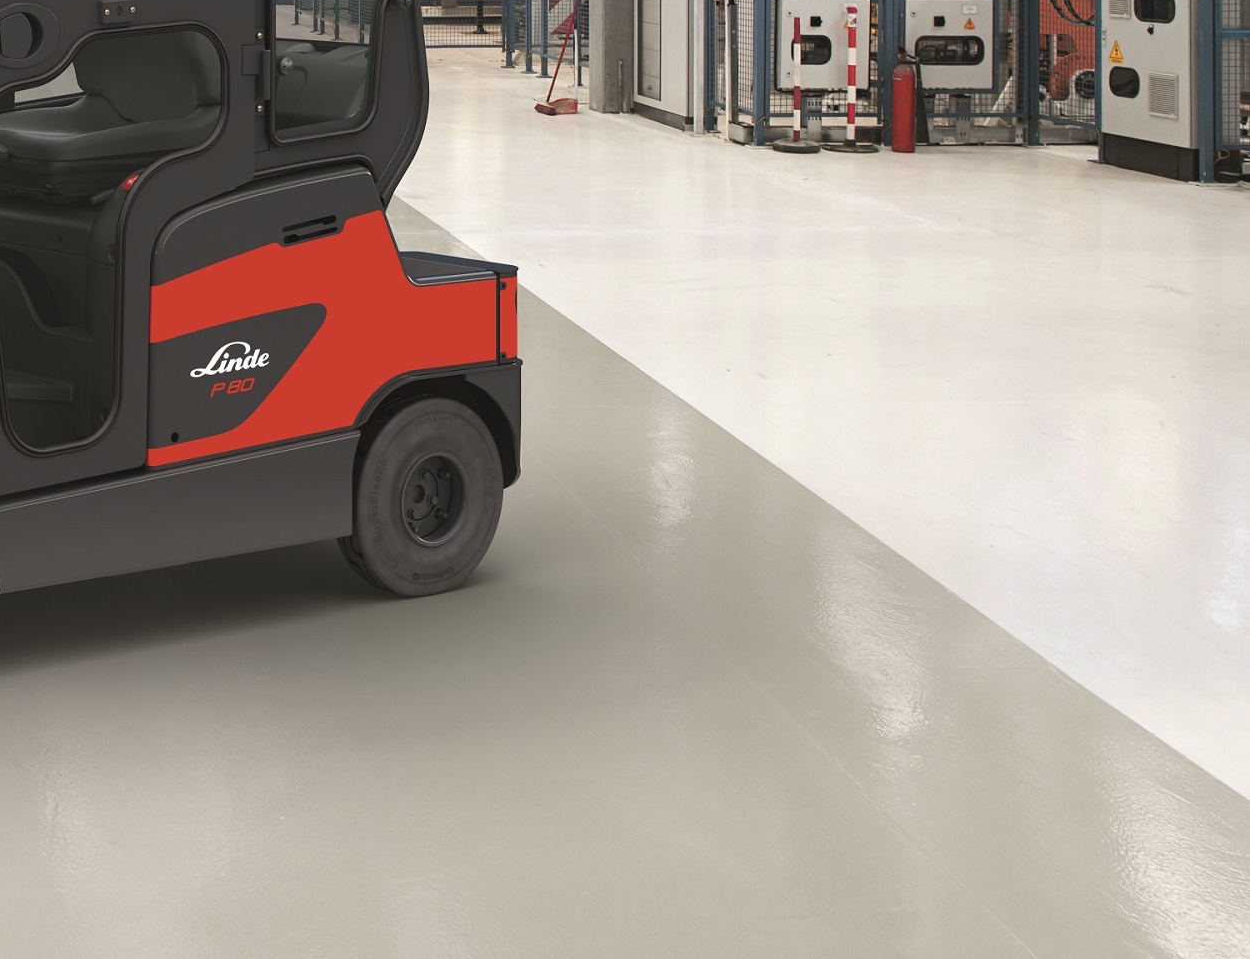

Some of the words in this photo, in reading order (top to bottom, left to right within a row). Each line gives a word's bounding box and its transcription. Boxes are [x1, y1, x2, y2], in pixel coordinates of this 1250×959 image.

[190, 341, 270, 378] Linde
[210, 382, 226, 398] P
[226, 377, 255, 394] 80
